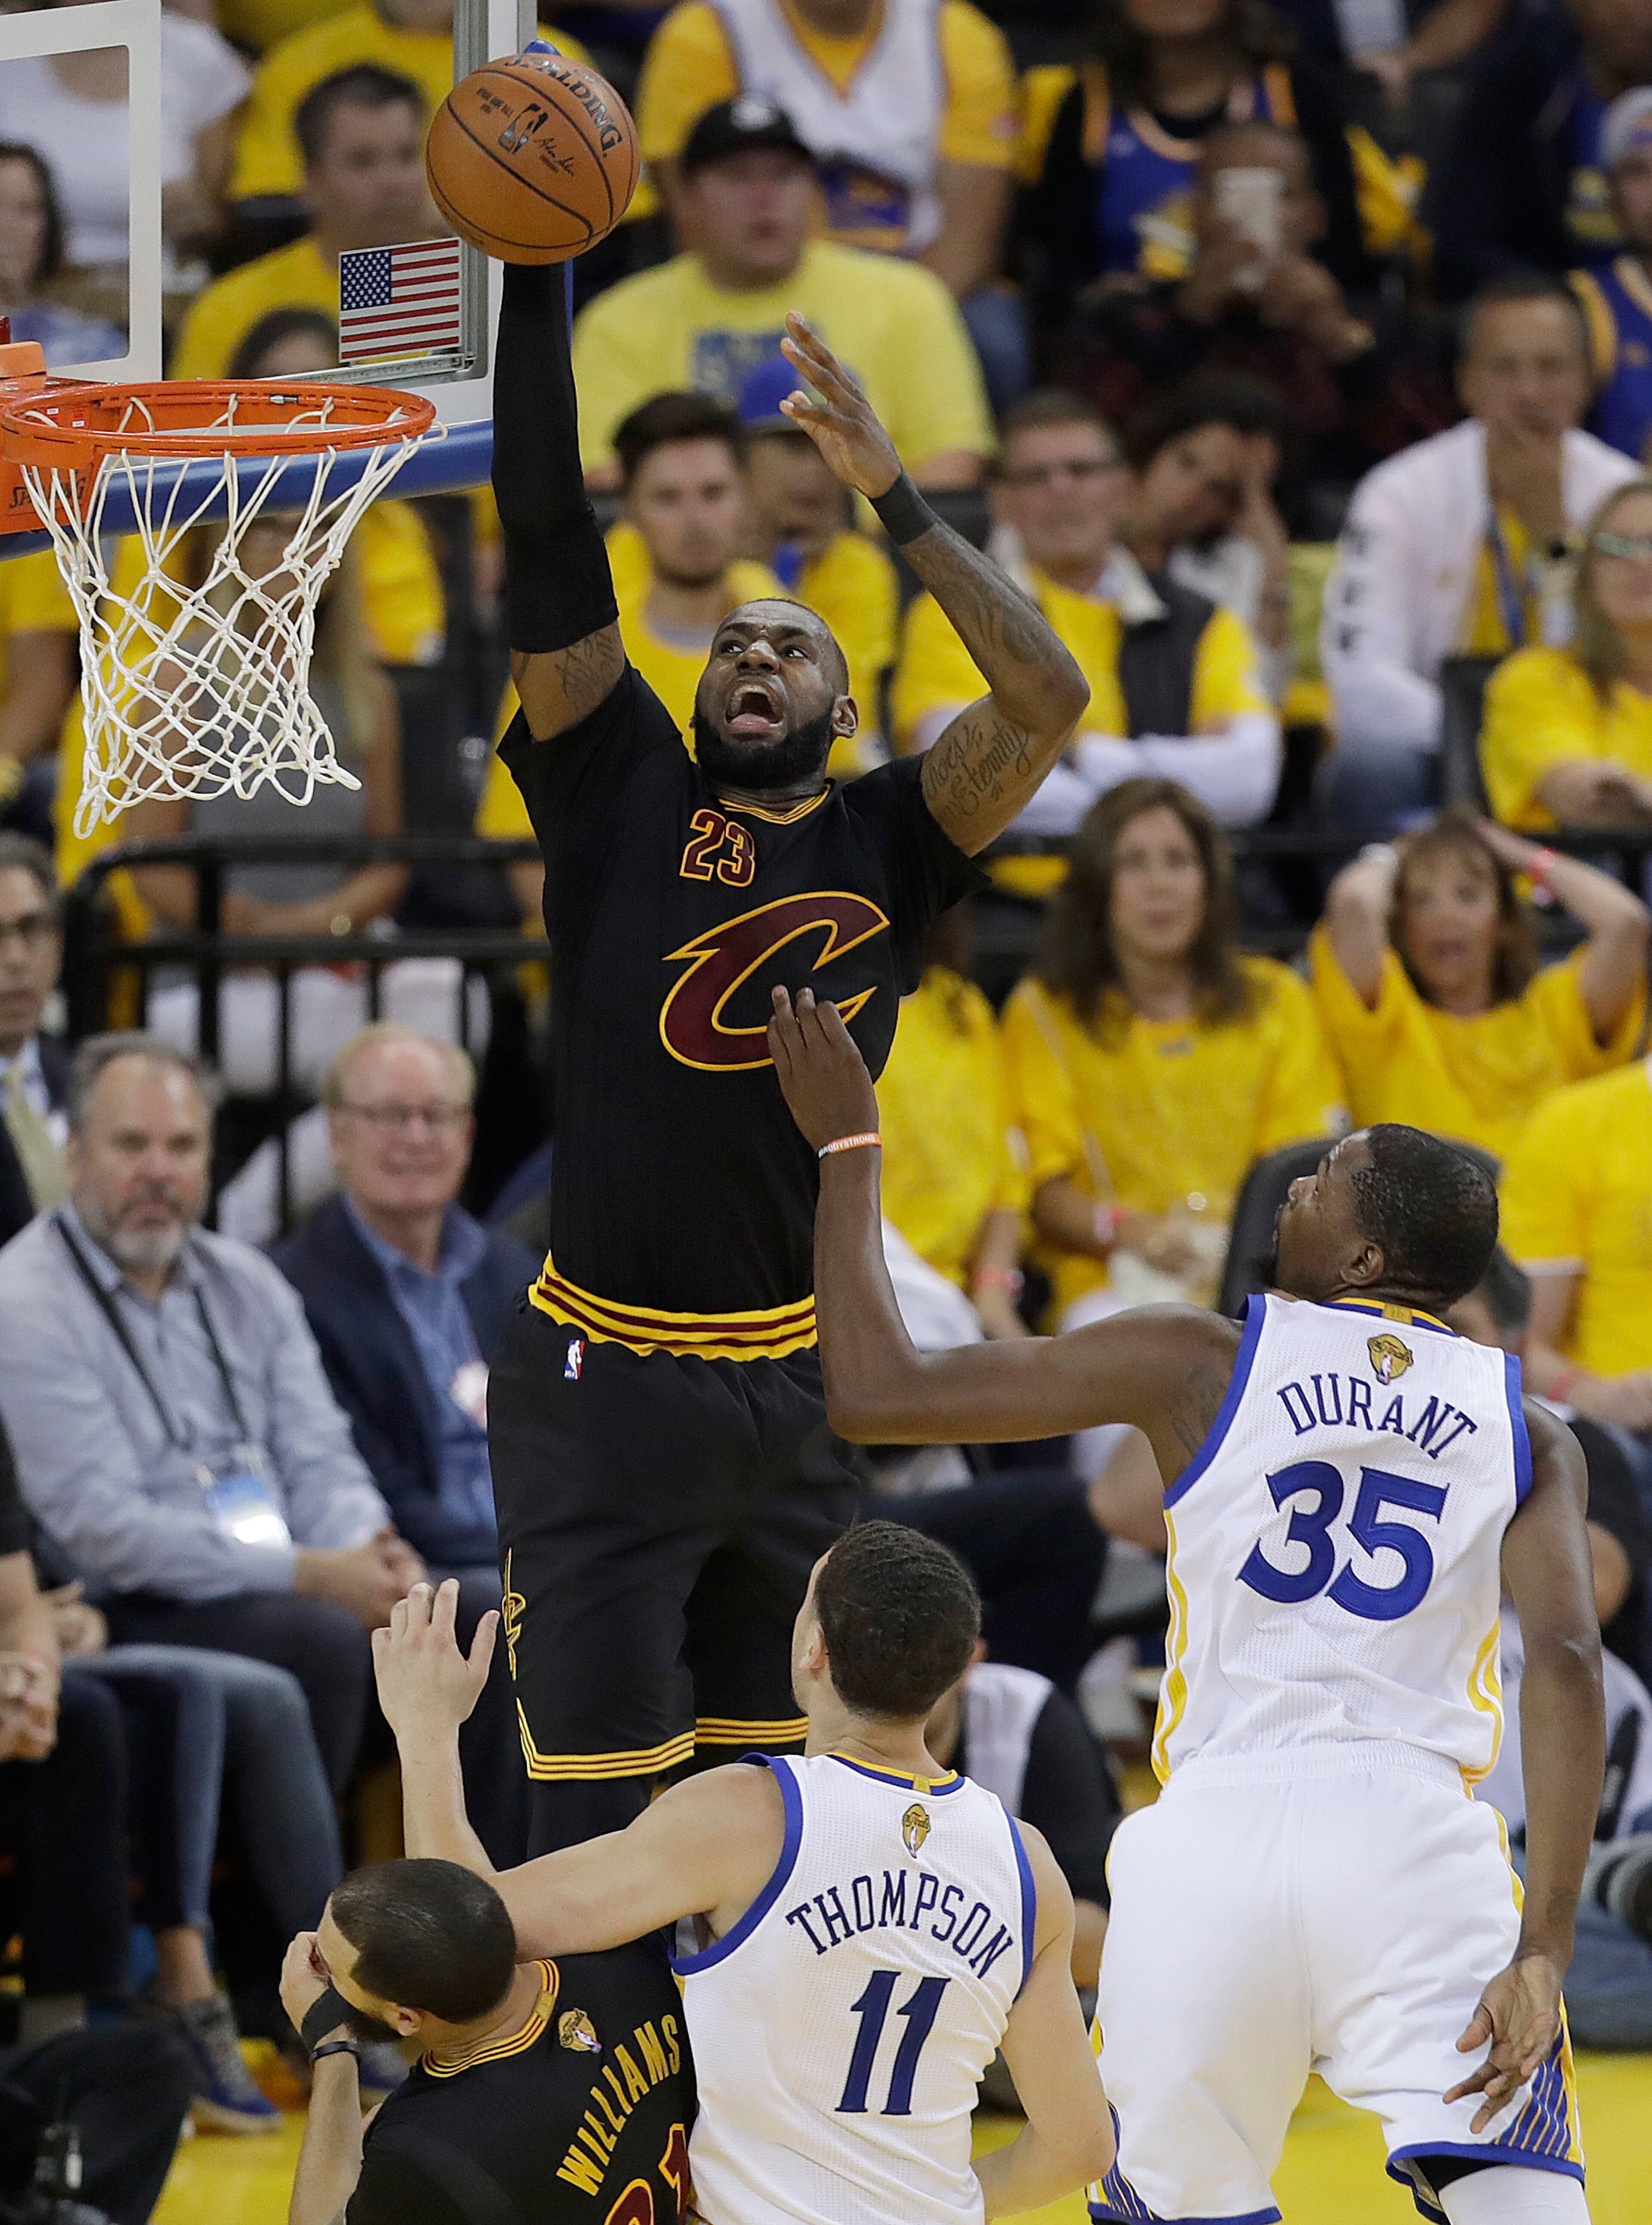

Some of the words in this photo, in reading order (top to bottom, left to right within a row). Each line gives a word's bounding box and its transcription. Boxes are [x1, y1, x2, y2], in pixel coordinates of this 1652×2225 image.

[679, 809, 755, 887] 23
[1276, 1373, 1478, 1460] DURANT
[1235, 1460, 1450, 1621] 35
[786, 1869, 1013, 1979] THOMPSON
[556, 2014, 681, 2196] WILLIAMS
[834, 1970, 952, 2116] 11
